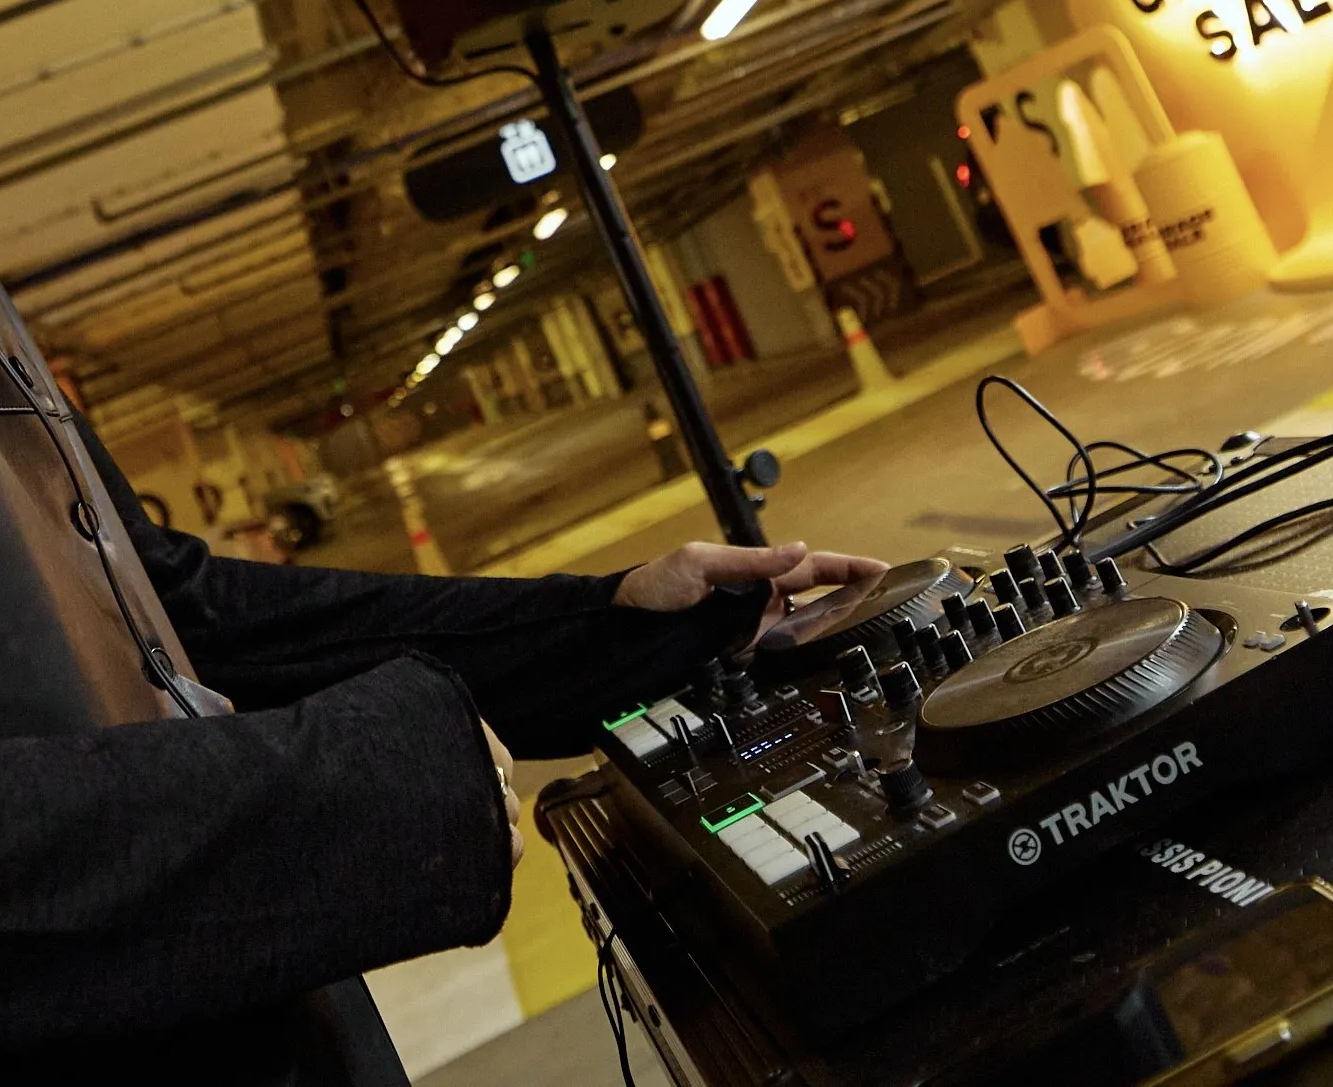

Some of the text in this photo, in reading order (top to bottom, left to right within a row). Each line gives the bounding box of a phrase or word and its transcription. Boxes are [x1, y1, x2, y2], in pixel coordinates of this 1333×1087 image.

[1039, 741, 1203, 845] TRAKTOR
[1137, 838, 1275, 907] SSIS PION
